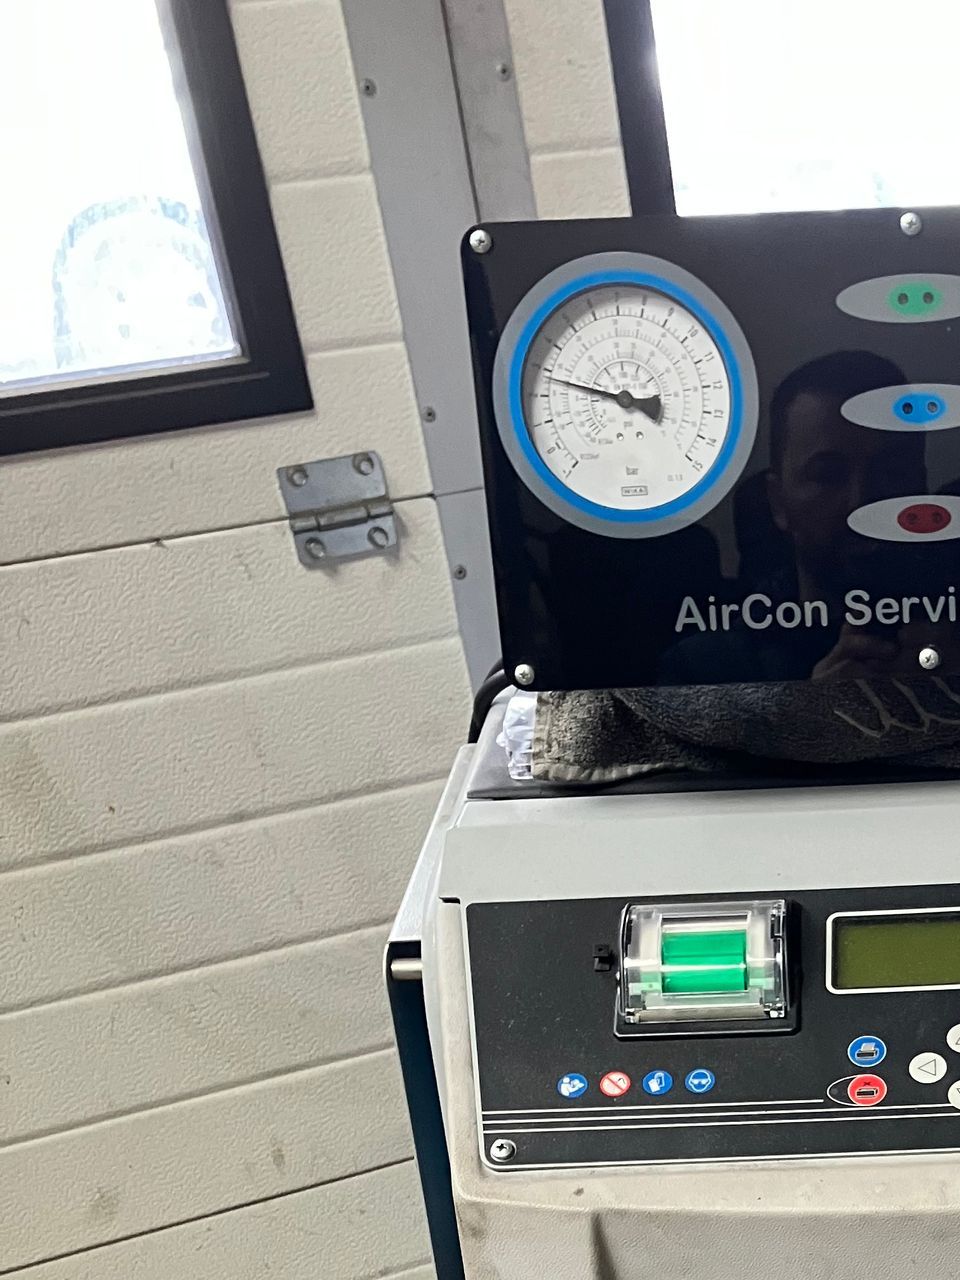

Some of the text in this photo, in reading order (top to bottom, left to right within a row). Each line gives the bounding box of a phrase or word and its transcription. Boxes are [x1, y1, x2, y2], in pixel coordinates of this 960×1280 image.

[687, 325, 698, 338] 10
[704, 351, 714, 362] 11
[712, 380, 723, 390] 12
[625, 465, 639, 476] bar
[692, 460, 703, 472] 15
[674, 593, 829, 633] AirCon
